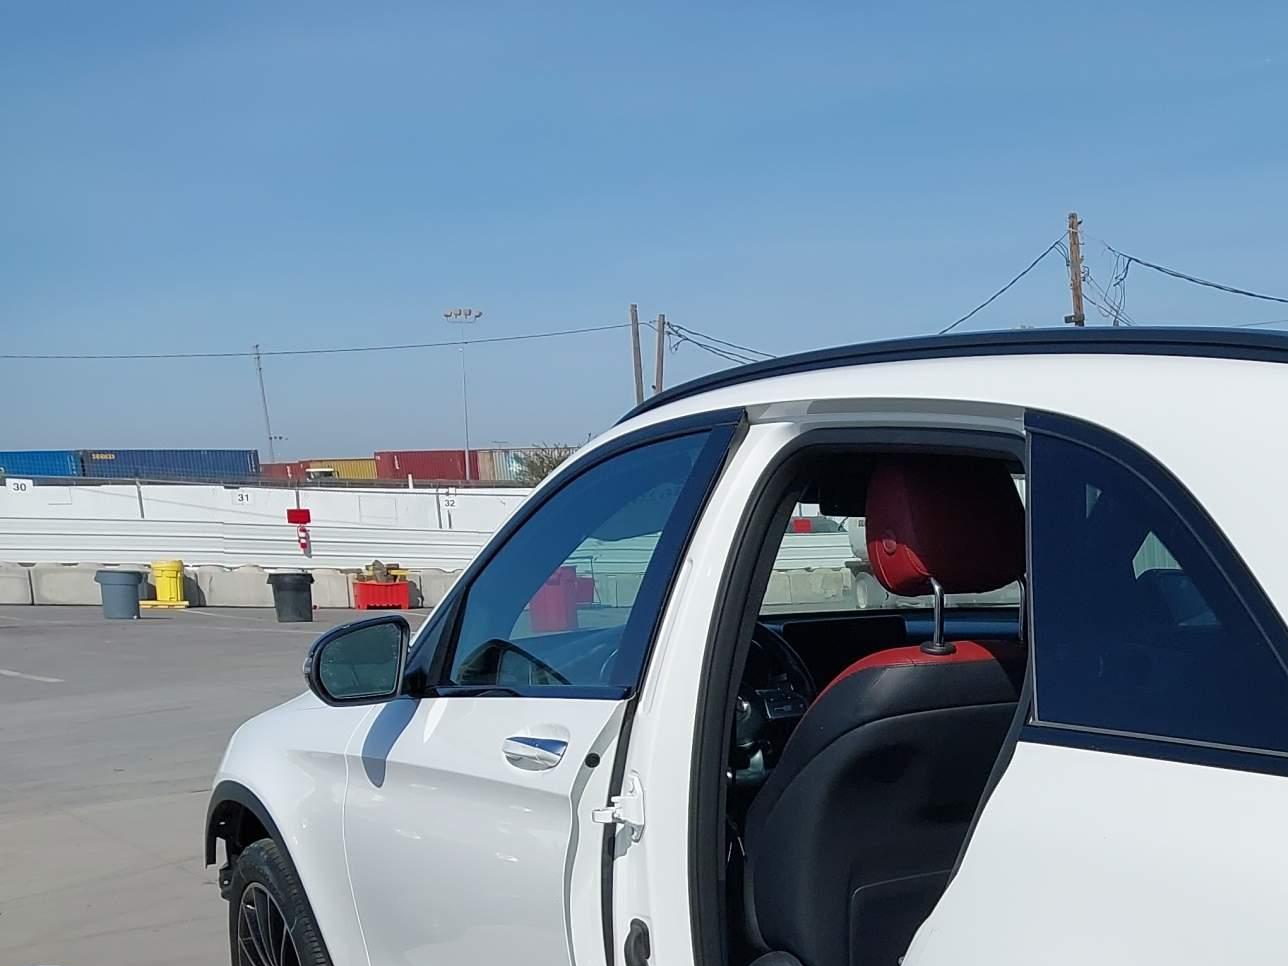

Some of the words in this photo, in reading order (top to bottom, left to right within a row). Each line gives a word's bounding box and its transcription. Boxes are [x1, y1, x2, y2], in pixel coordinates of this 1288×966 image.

[13, 482, 27, 492] 30
[237, 493, 249, 502] 31
[444, 499, 456, 507] 32
